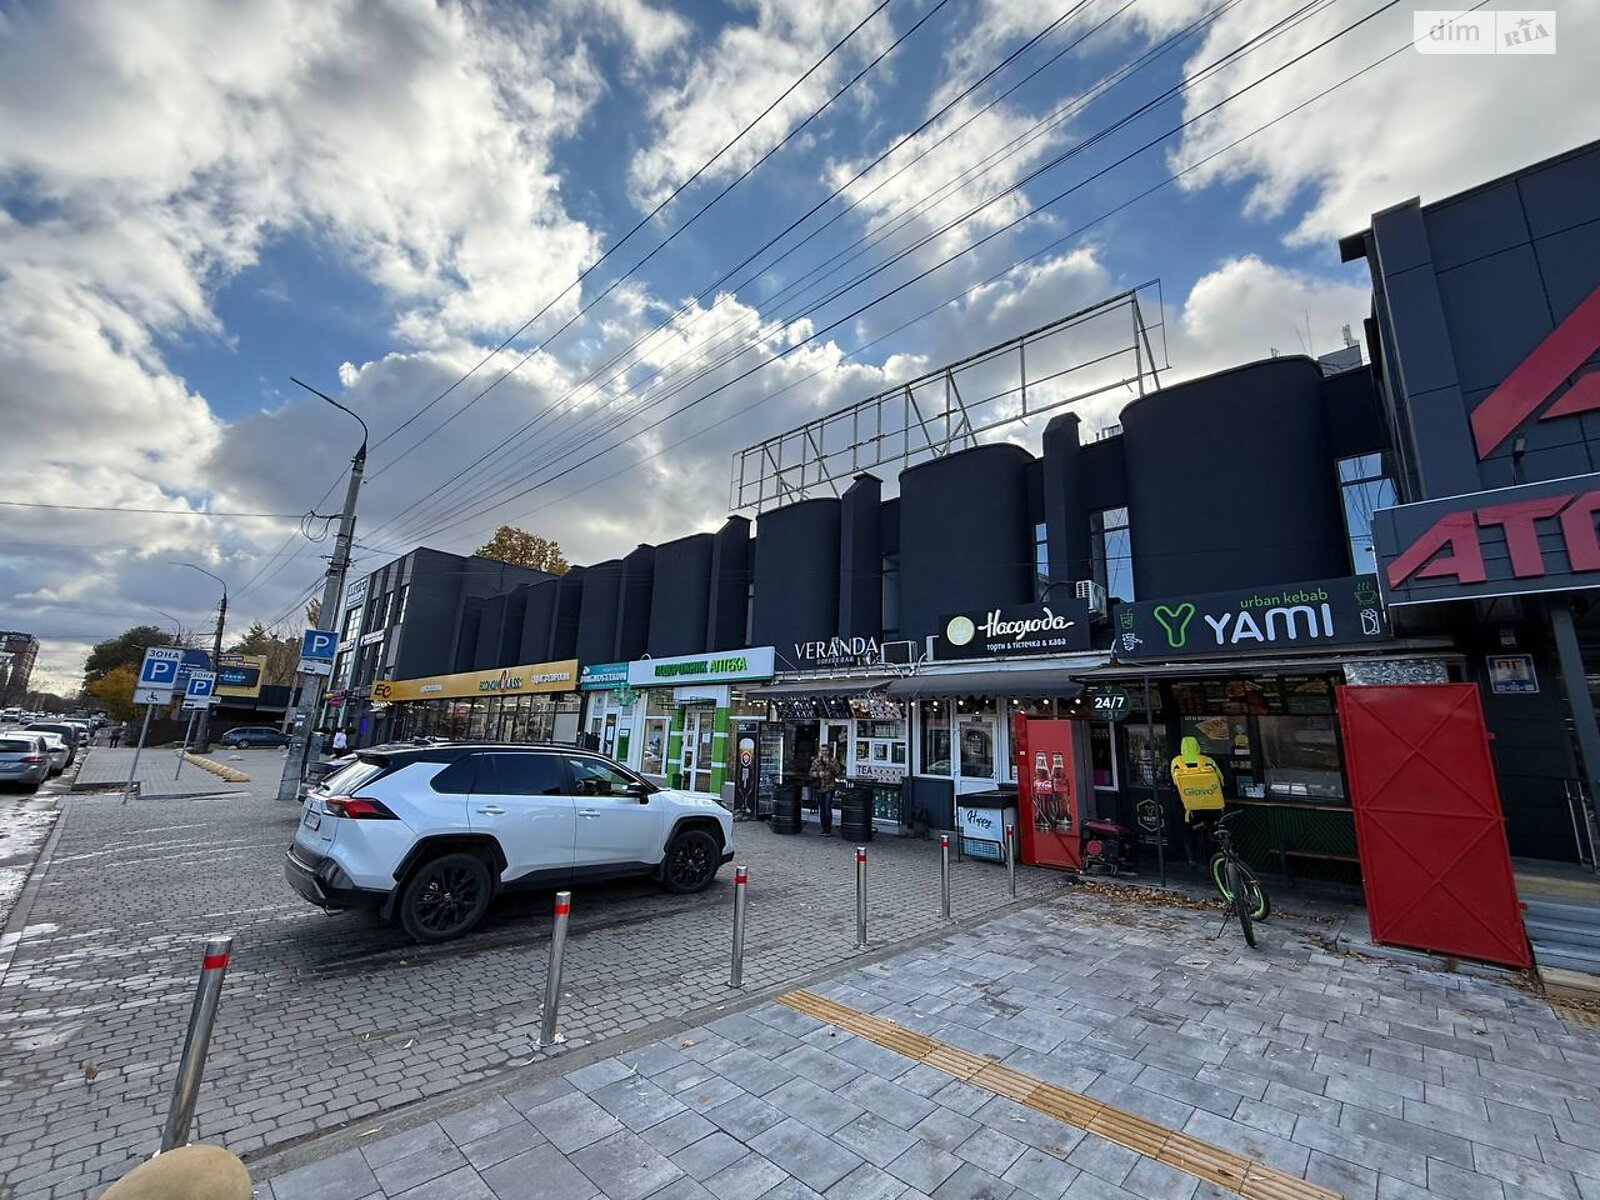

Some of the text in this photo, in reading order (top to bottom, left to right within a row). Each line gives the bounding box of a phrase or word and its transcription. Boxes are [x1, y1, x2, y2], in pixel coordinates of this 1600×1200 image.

[1240, 588, 1328, 608] urban kebab
[1204, 603, 1335, 645] YAMI
[312, 635, 330, 653] P
[794, 636, 879, 660] VERANDA
[987, 643, 1005, 652] торти
[1049, 638, 1066, 646] кава
[148, 649, 180, 659] ЗОНА
[150, 662, 169, 680] P
[192, 671, 215, 680] ЗОНА
[194, 681, 206, 693] P
[1094, 696, 1125, 709] 24/7
[858, 766, 873, 775] TEA
[1184, 784, 1215, 797] Glovo
